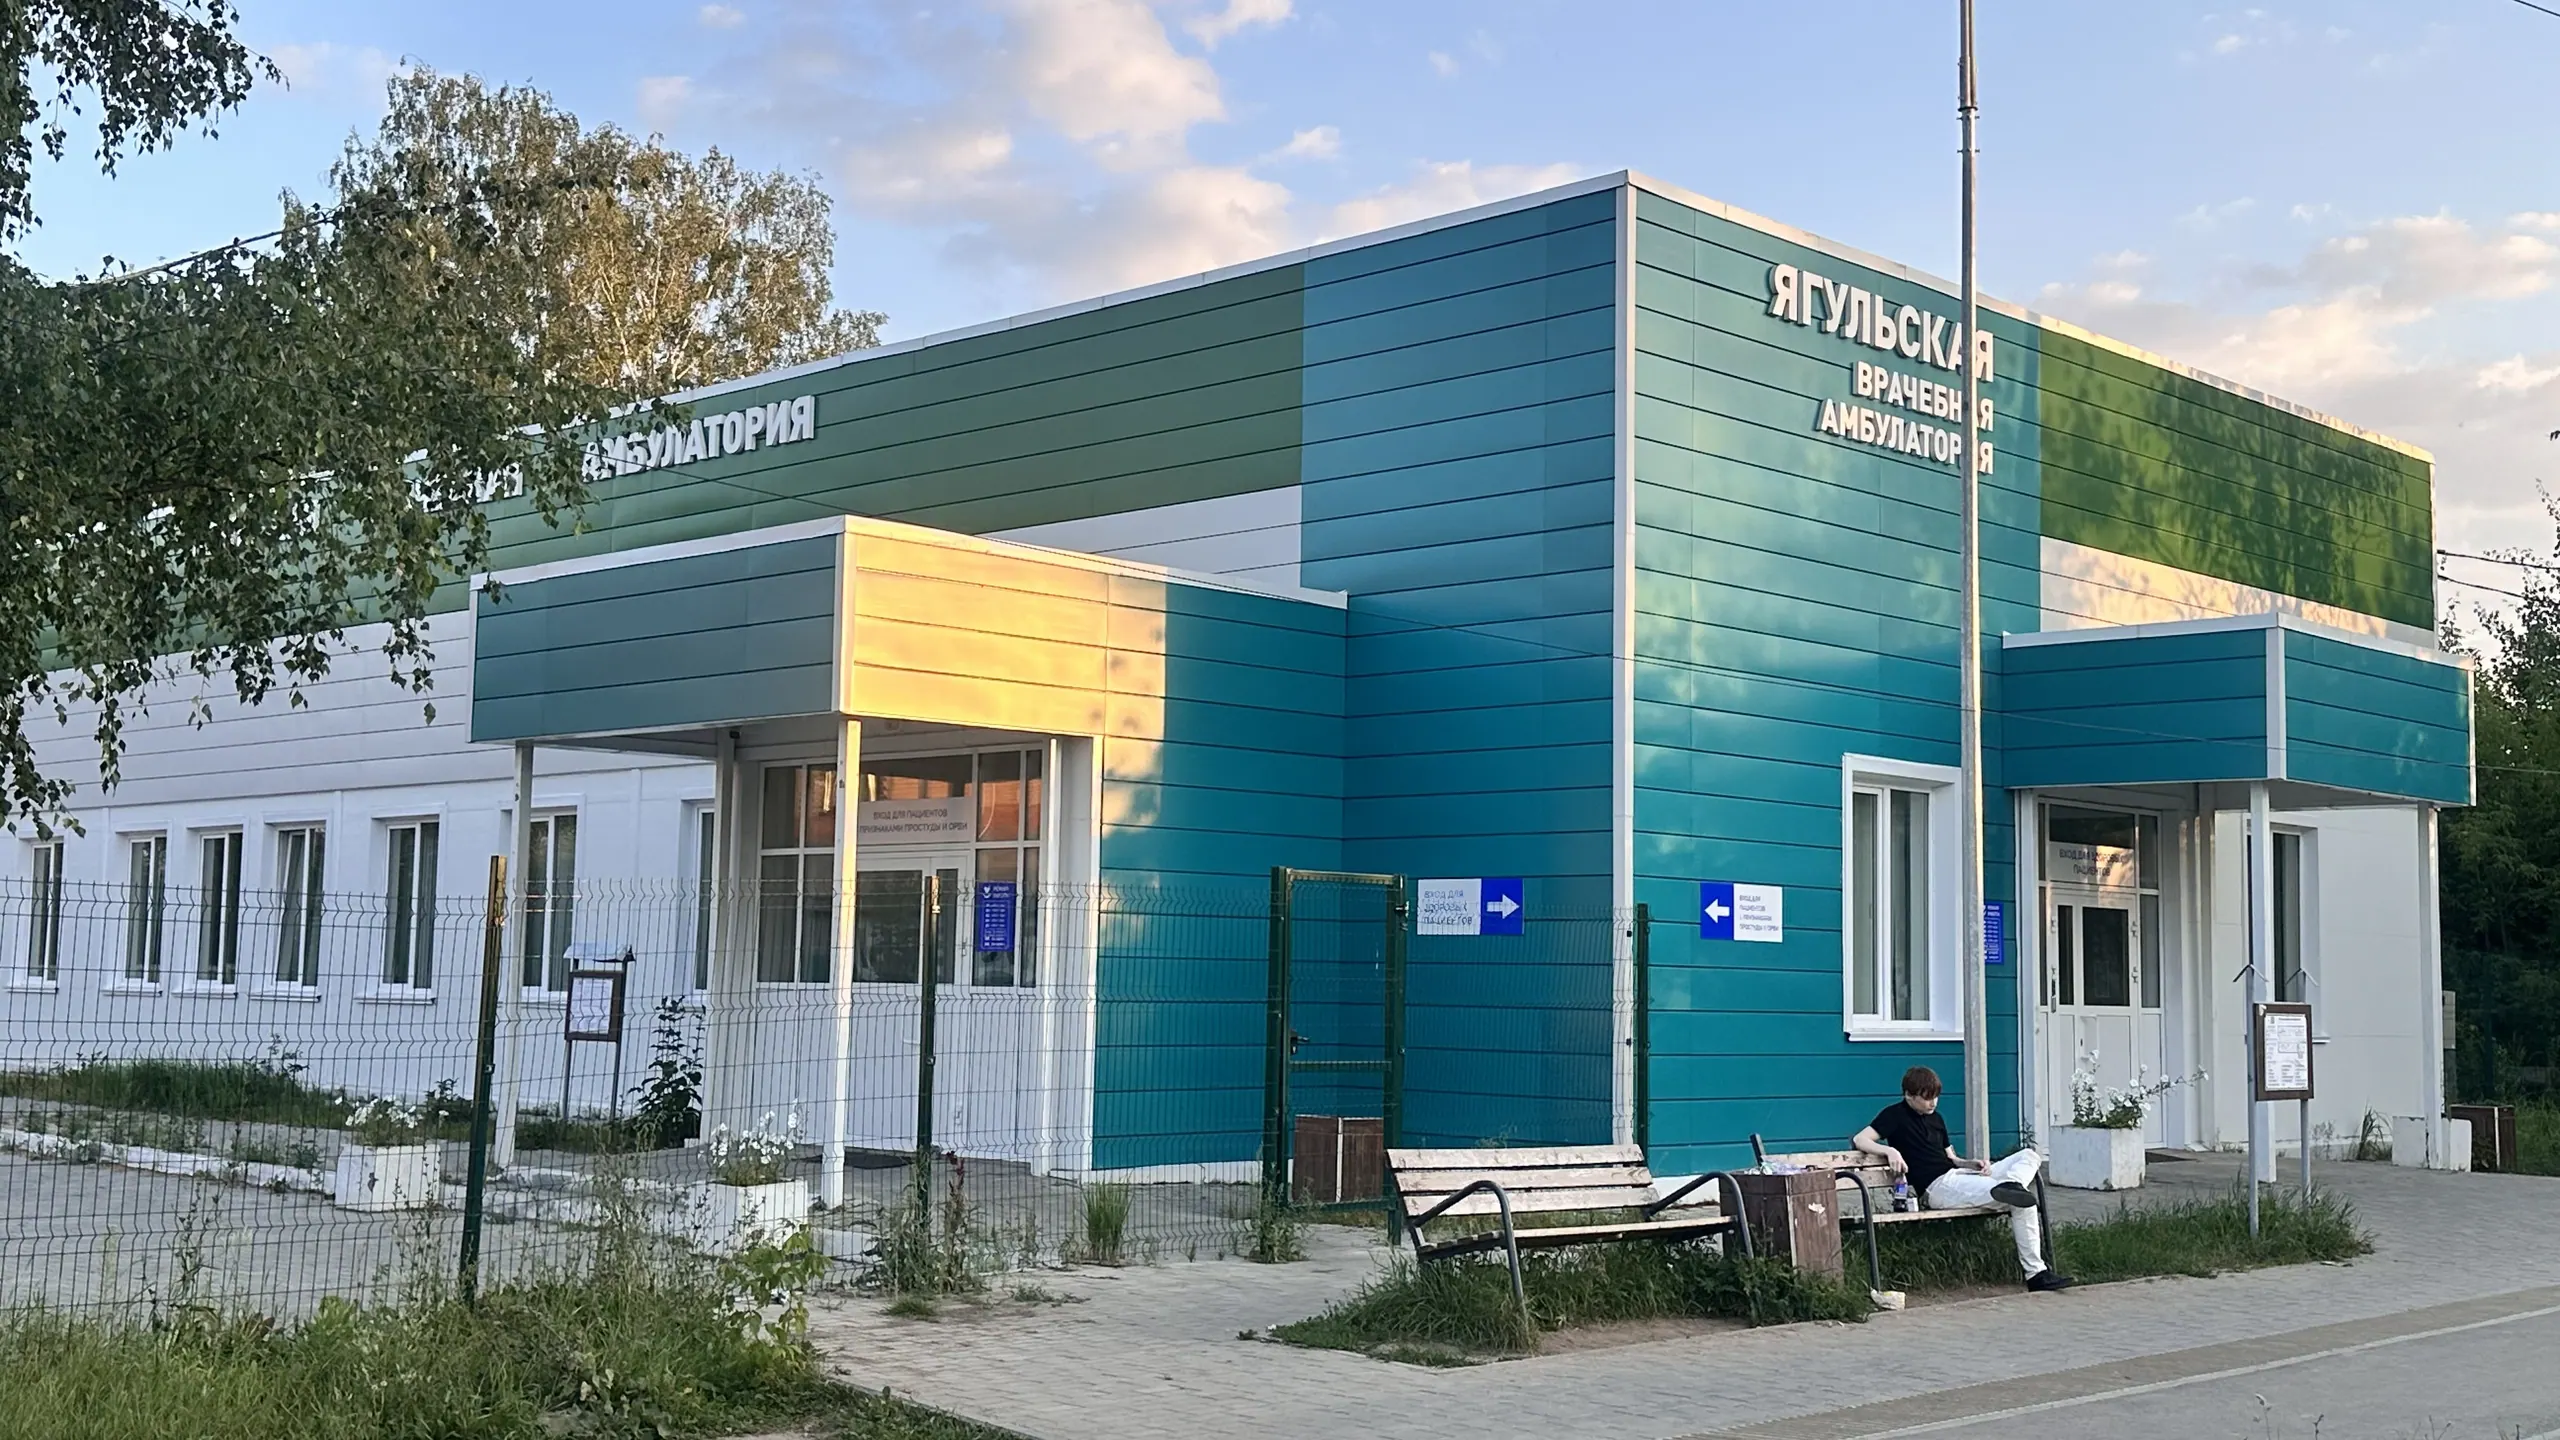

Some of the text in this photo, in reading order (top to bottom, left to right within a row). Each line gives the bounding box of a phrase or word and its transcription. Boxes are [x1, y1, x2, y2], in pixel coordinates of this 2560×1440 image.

[1768, 263, 1994, 383] ЯГУЛЬСКАЯ
[1853, 360, 1994, 432] ВРАЧЕБНЯ
[581, 395, 817, 482] АМБУЛАТОРИЯ
[1815, 398, 1994, 475] АМБУЛАТОРЯ
[904, 822, 940, 833] ПРОСТУДЫ
[907, 808, 948, 819] ПАЦИЕНТОВ
[1424, 889, 1464, 899] ВХОД ДЛЯ
